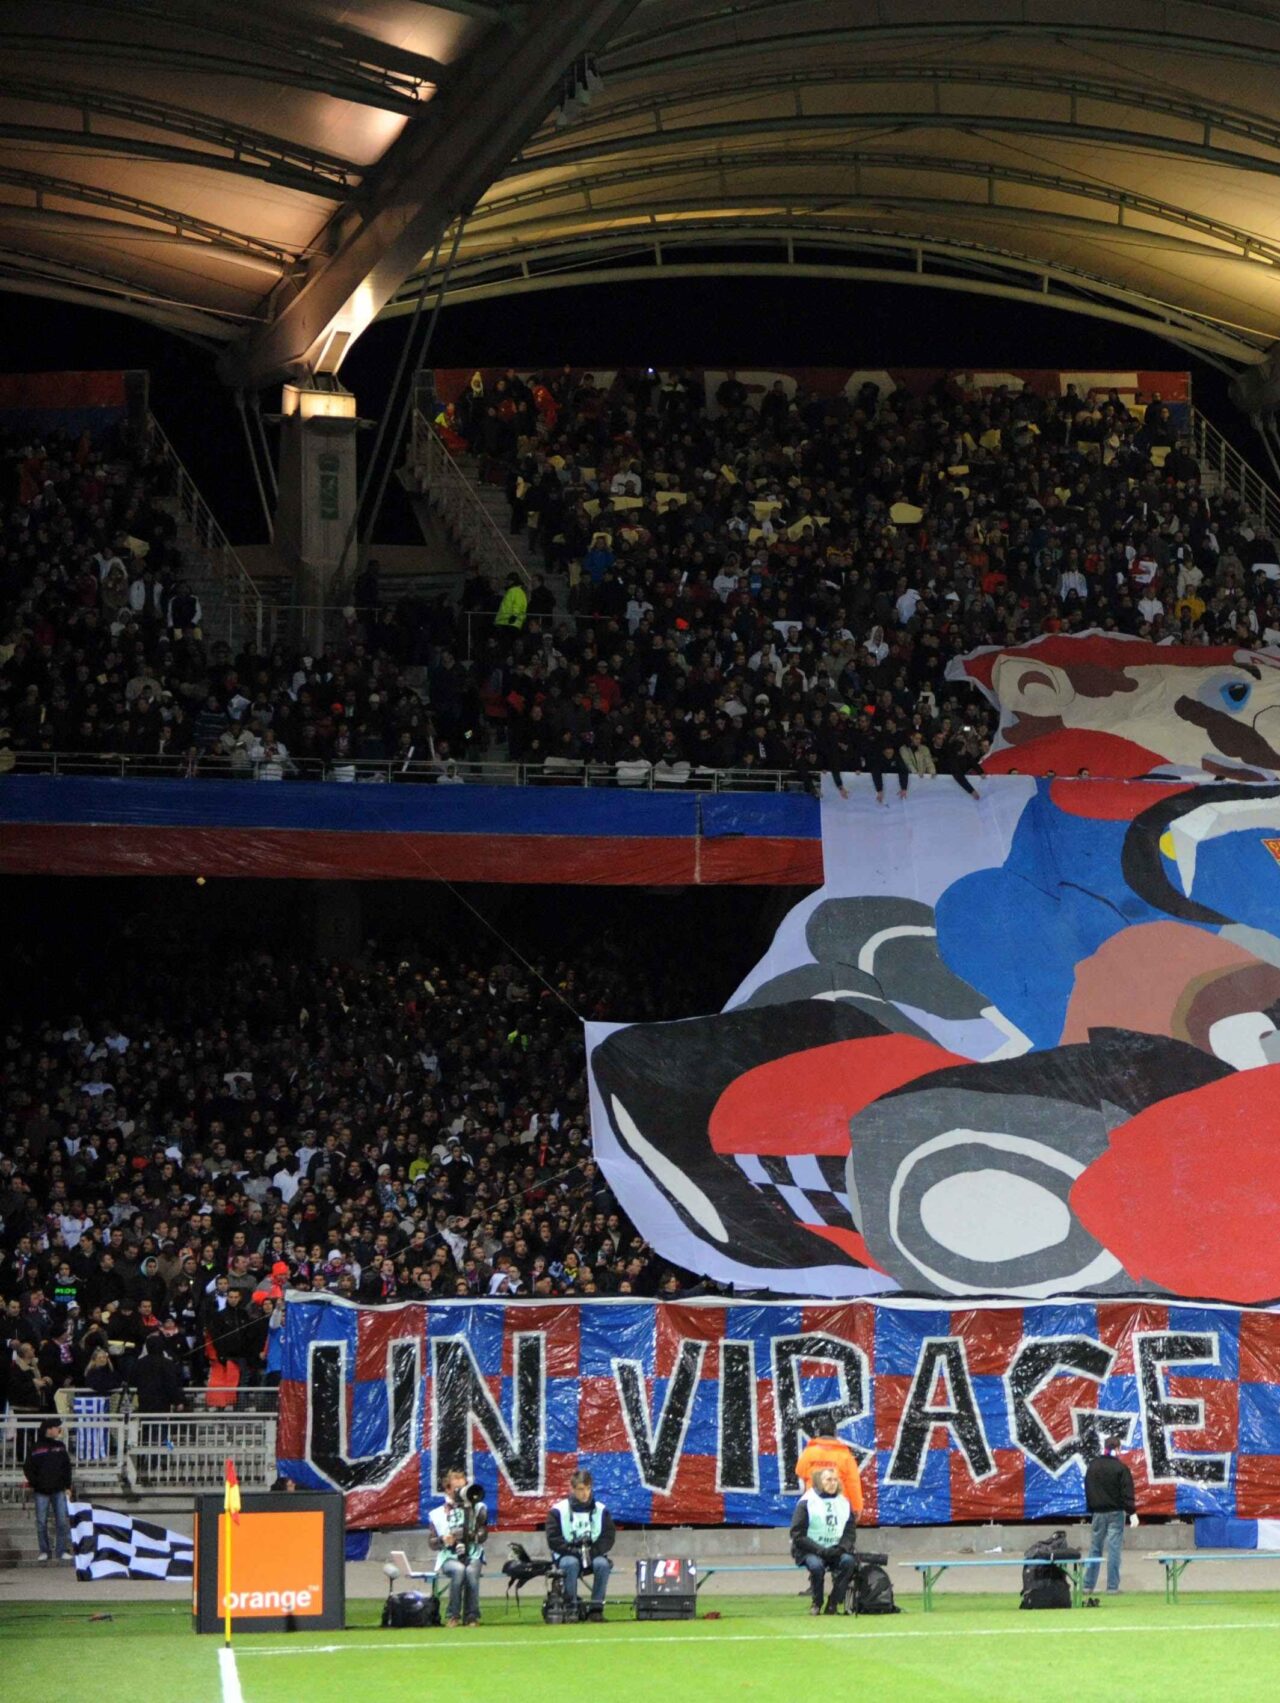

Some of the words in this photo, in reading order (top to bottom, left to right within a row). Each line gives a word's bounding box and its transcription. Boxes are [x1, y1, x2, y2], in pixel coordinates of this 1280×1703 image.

[305, 1330, 547, 1496] UN
[609, 1330, 1234, 1496] VIRAGE
[223, 1589, 312, 1613] orange
